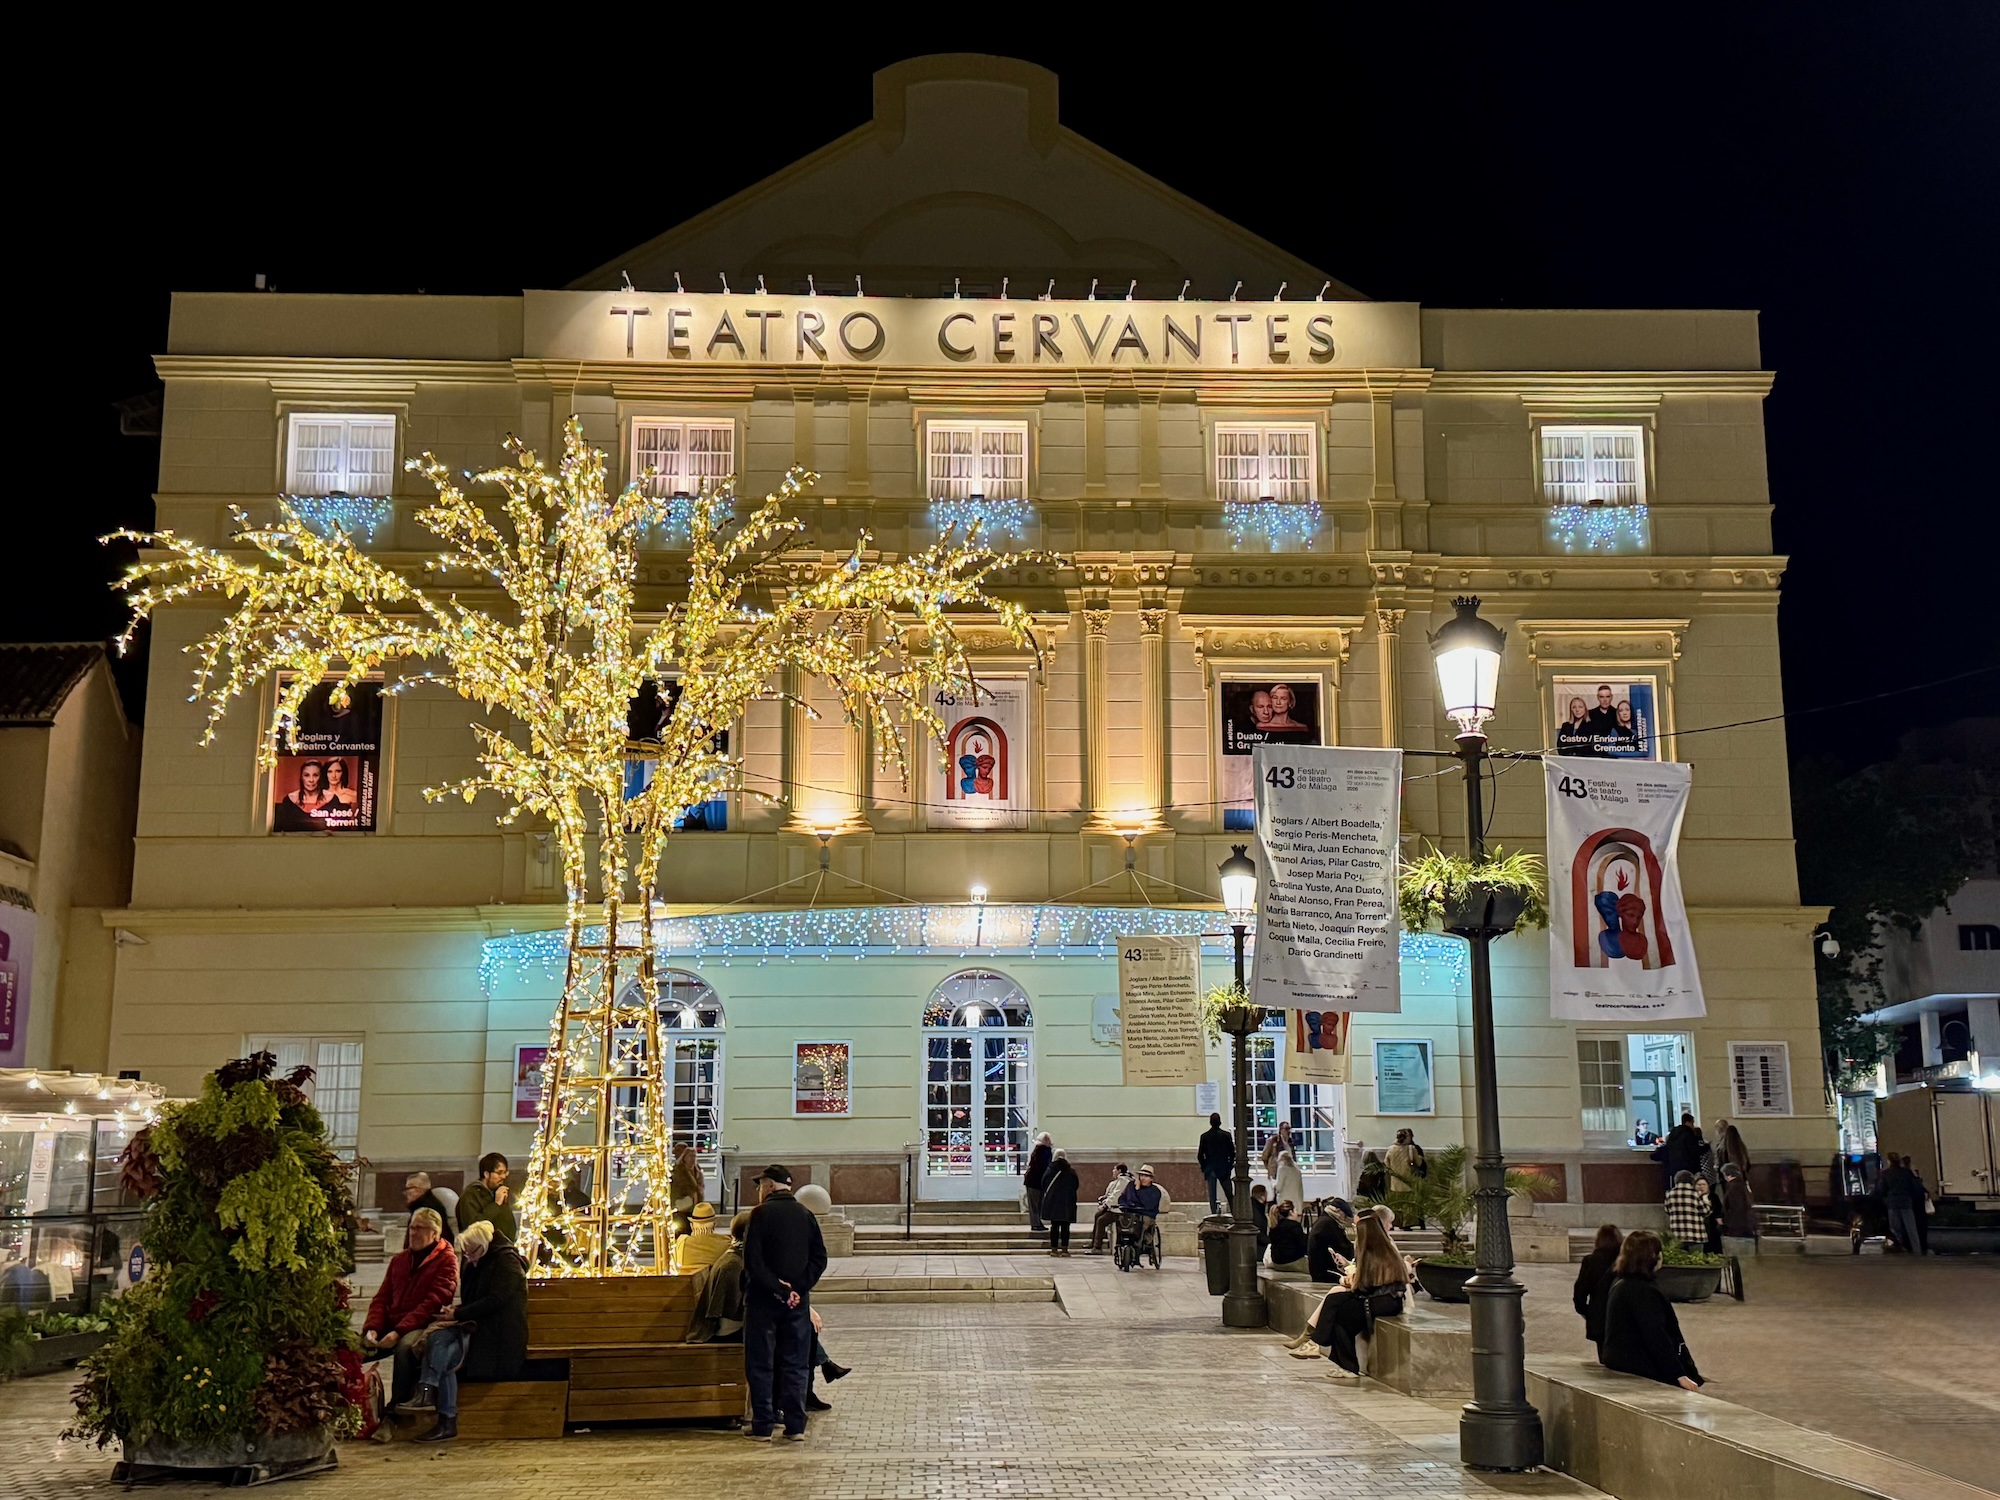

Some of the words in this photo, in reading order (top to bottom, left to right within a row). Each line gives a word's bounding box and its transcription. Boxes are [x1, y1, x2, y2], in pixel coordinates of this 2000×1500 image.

[610, 306, 885, 361] TEATRO
[938, 312, 1335, 363] CERVANTES
[935, 691, 955, 706] 43
[299, 733, 332, 741] Joglars
[1266, 767, 1295, 789] 43
[1309, 783, 1337, 792] Málaga
[1558, 776, 1587, 798] 43
[1601, 794, 1628, 804] Málaga
[310, 809, 328, 817] San
[330, 808, 352, 817] José
[325, 818, 358, 826] Torrent
[1271, 816, 1303, 826] Joglars
[1311, 818, 1338, 827] Albert
[1341, 819, 1382, 829] Boadella,
[1274, 829, 1302, 839] Sergio
[1305, 831, 1378, 843] Peris-Mencheta,
[1266, 840, 1290, 852] Magüi
[1293, 844, 1315, 854] Mira,
[1318, 844, 1340, 853] Juan
[1342, 845, 1388, 856] Echanove,
[1271, 854, 1298, 865] Imanol
[1300, 856, 1326, 867] Arias,
[1329, 858, 1349, 867] Pilar
[1351, 859, 1383, 870] Castro,
[1287, 869, 1313, 879] Josep
[1269, 880, 1303, 891] Carolina
[1305, 881, 1332, 893] Yuste,
[1335, 884, 1352, 893] Ana
[1356, 885, 1385, 896] Duato,
[1269, 893, 1296, 903] Anabel
[1299, 895, 1332, 906] Alonso,
[1334, 898, 1354, 907] Fran
[1357, 899, 1385, 908] Perea,
[1266, 906, 1288, 915] María
[1291, 907, 1332, 920] Barranco,
[1334, 911, 1352, 920] Ana
[1355, 912, 1389, 921] Torrent,
[1267, 918, 1290, 928] Marta
[1293, 922, 1317, 932] Nieto,
[1319, 924, 1355, 935] Joaquín
[1357, 926, 1388, 935] Reyes,
[1268, 932, 1295, 943] Coque
[1298, 935, 1322, 946] Malla,
[1325, 938, 1355, 946] Cecilia
[1357, 938, 1386, 948] Freire,
[1125, 949, 1141, 961] 43
[1313, 950, 1363, 960] Grandinetti
